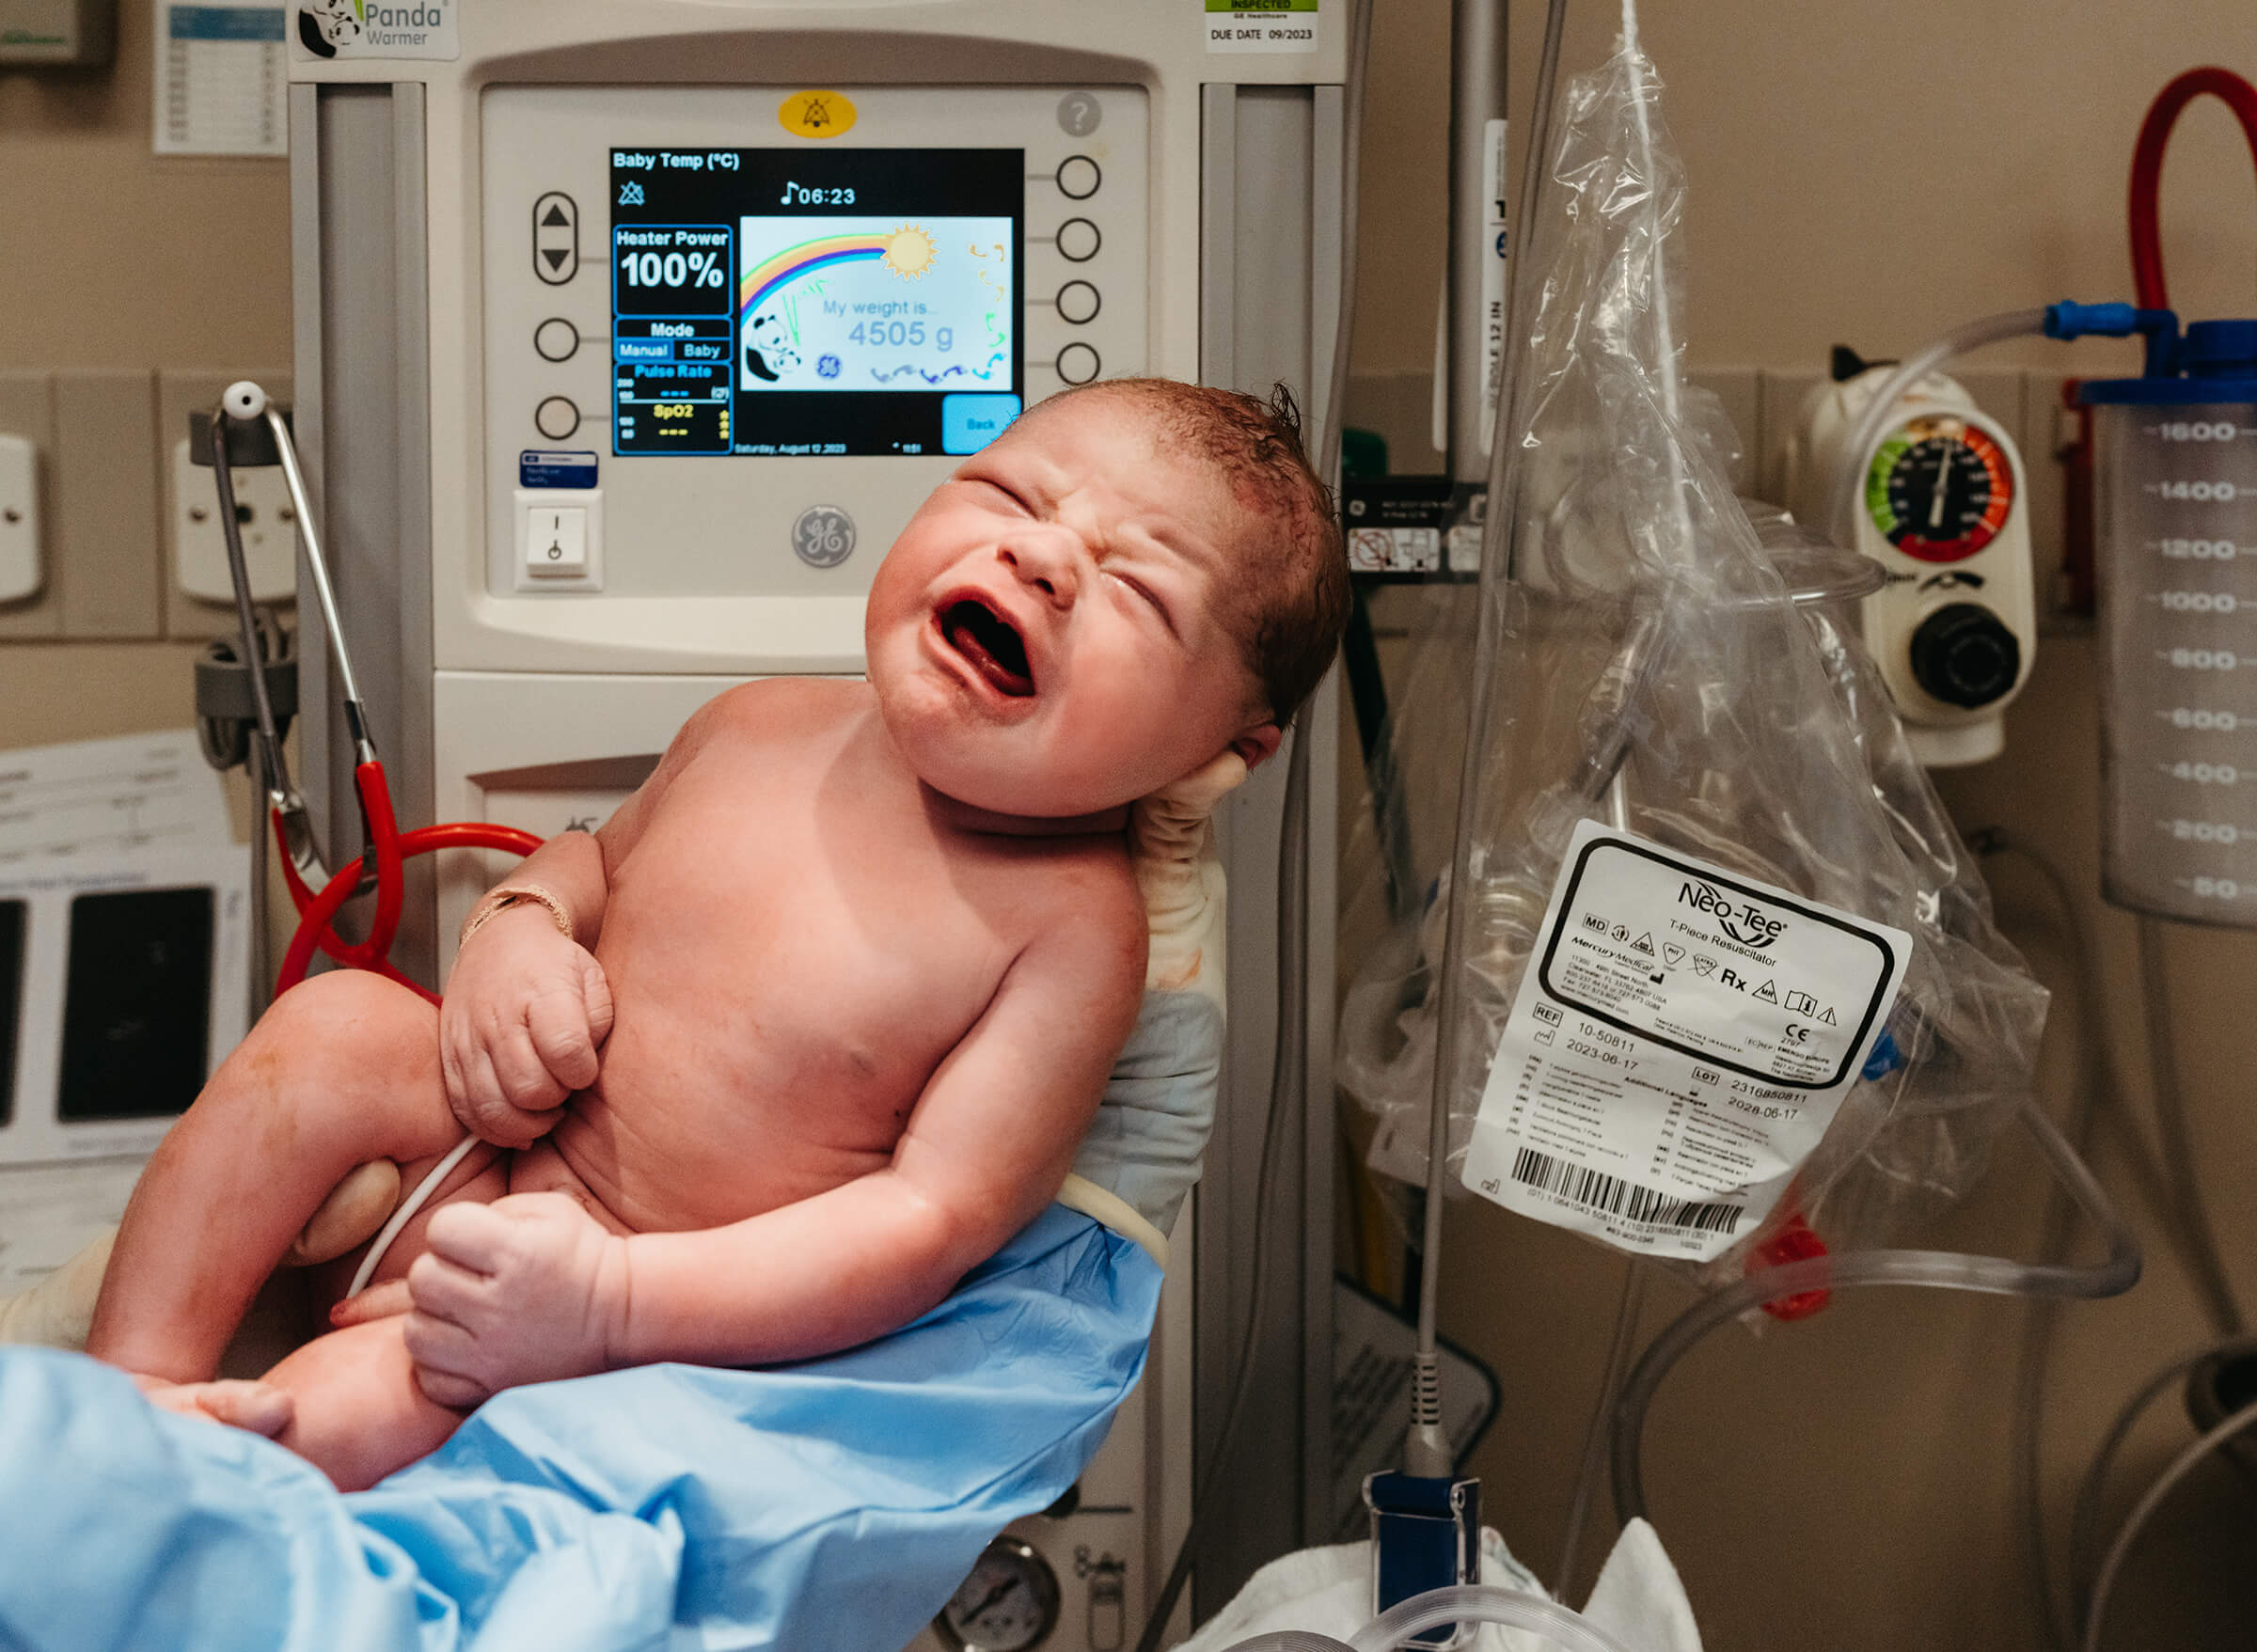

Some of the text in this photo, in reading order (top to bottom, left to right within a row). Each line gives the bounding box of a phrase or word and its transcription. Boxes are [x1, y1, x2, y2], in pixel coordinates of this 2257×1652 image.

[365, 2, 441, 26] Panda
[367, 30, 428, 45] Warmer
[1211, 29, 1312, 39] DUE DATE 09/2023
[613, 152, 656, 170] Baby
[660, 152, 703, 170] Temp
[798, 188, 856, 204] 06:23
[616, 230, 729, 245] Heater Power
[621, 252, 724, 288] 100%
[824, 300, 846, 317] My
[853, 300, 908, 317] weight
[1490, 301, 1502, 319] IN
[650, 323, 695, 337] Mode
[848, 321, 954, 353] 4505 g
[1490, 323, 1501, 341] 12
[620, 344, 668, 356] Manual
[684, 343, 721, 359] Baby
[634, 365, 713, 378] Pulse Rate
[654, 404, 694, 419] SpO2
[2161, 421, 2235, 441] 1600
[2162, 480, 2235, 500] 1400
[2162, 538, 2235, 560] 1200
[2162, 591, 2235, 613] 1000
[2171, 648, 2236, 670] 800
[2172, 707, 2237, 731] 600
[2173, 762, 2237, 785] 400
[2173, 820, 2237, 843] 200
[2194, 876, 2237, 900] 50
[1586, 916, 1606, 932] MD
[1669, 918, 1776, 968] T-Piece Resuscitator
[1631, 977, 1649, 988] North
[1720, 968, 1747, 992] Rx
[1651, 994, 1667, 1004] USA
[1537, 1006, 1559, 1023] REF
[1579, 1021, 1634, 1053] 10-50811
[1785, 1023, 1810, 1042] CE
[1567, 1038, 1639, 1071] 2023-06-17
[1696, 1068, 1717, 1083] LOT
[1665, 1090, 1708, 1108] Languages
[1728, 1096, 1798, 1120] 2028-06-17
